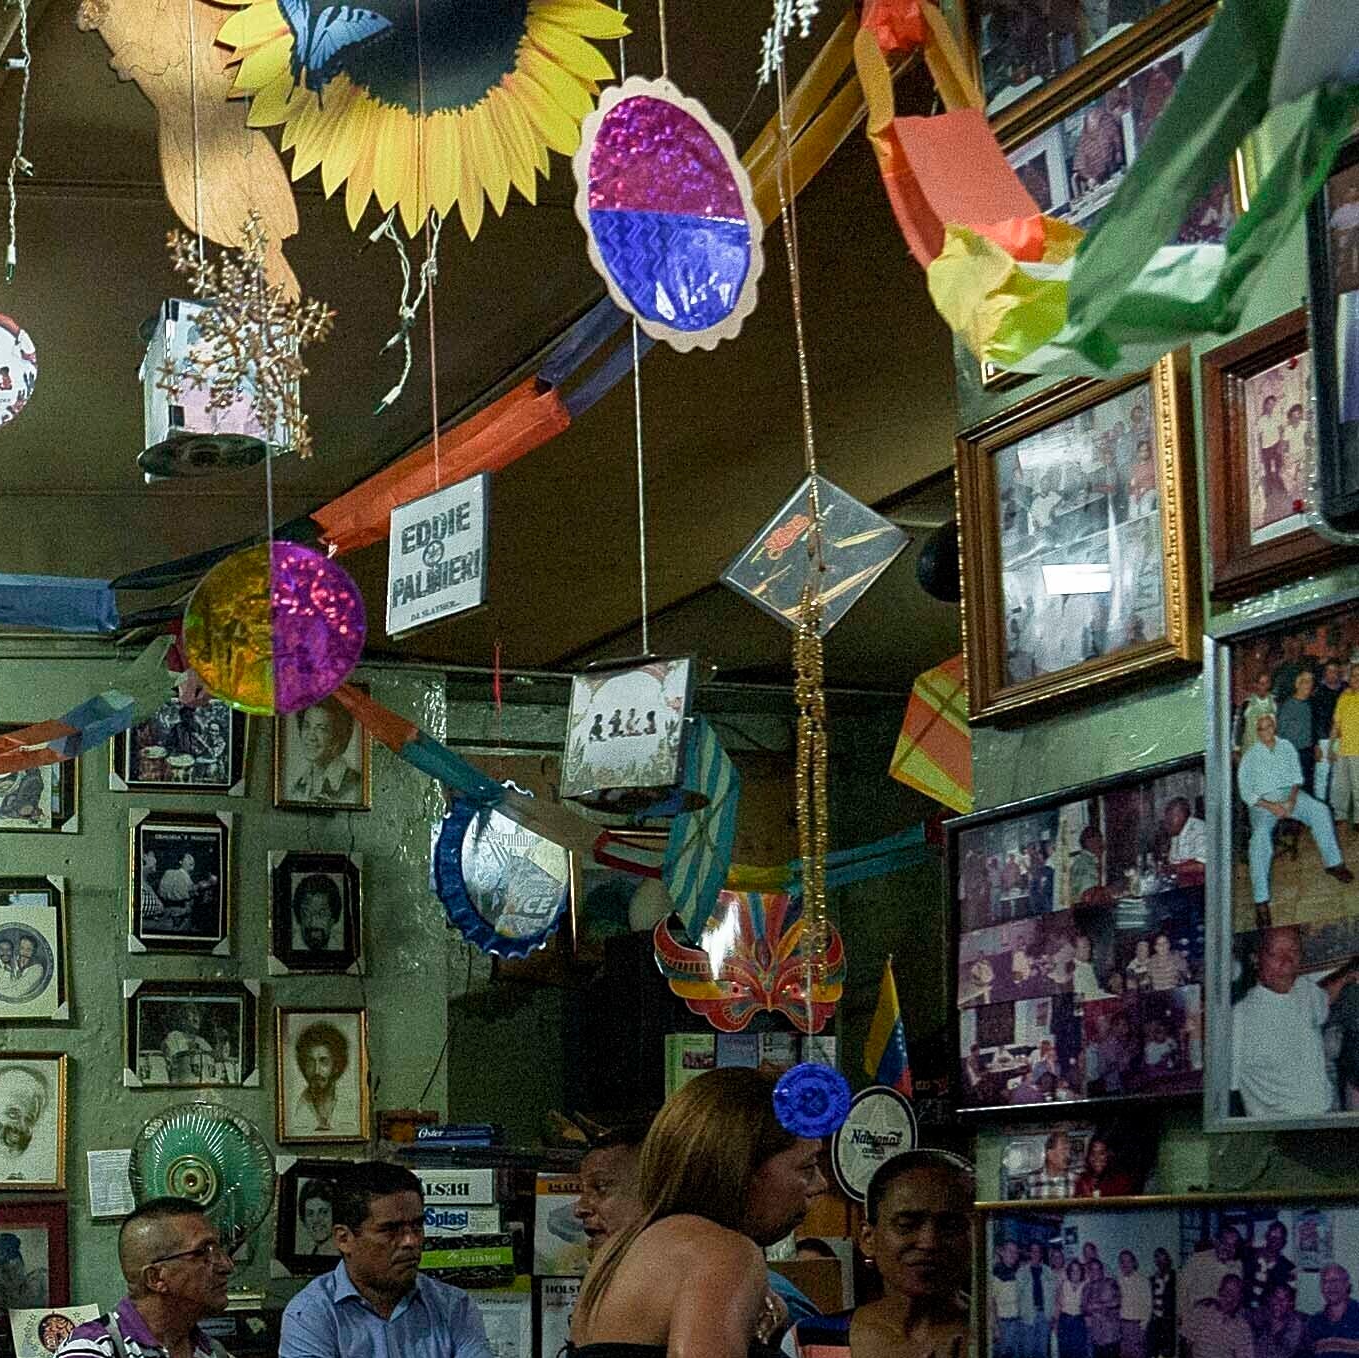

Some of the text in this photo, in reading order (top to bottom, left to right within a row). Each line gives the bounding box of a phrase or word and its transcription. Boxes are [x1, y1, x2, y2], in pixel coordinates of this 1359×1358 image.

[401, 501, 471, 555] EDDIE
[392, 548, 481, 609] PALMIERI
[417, 1126, 445, 1139] Oster
